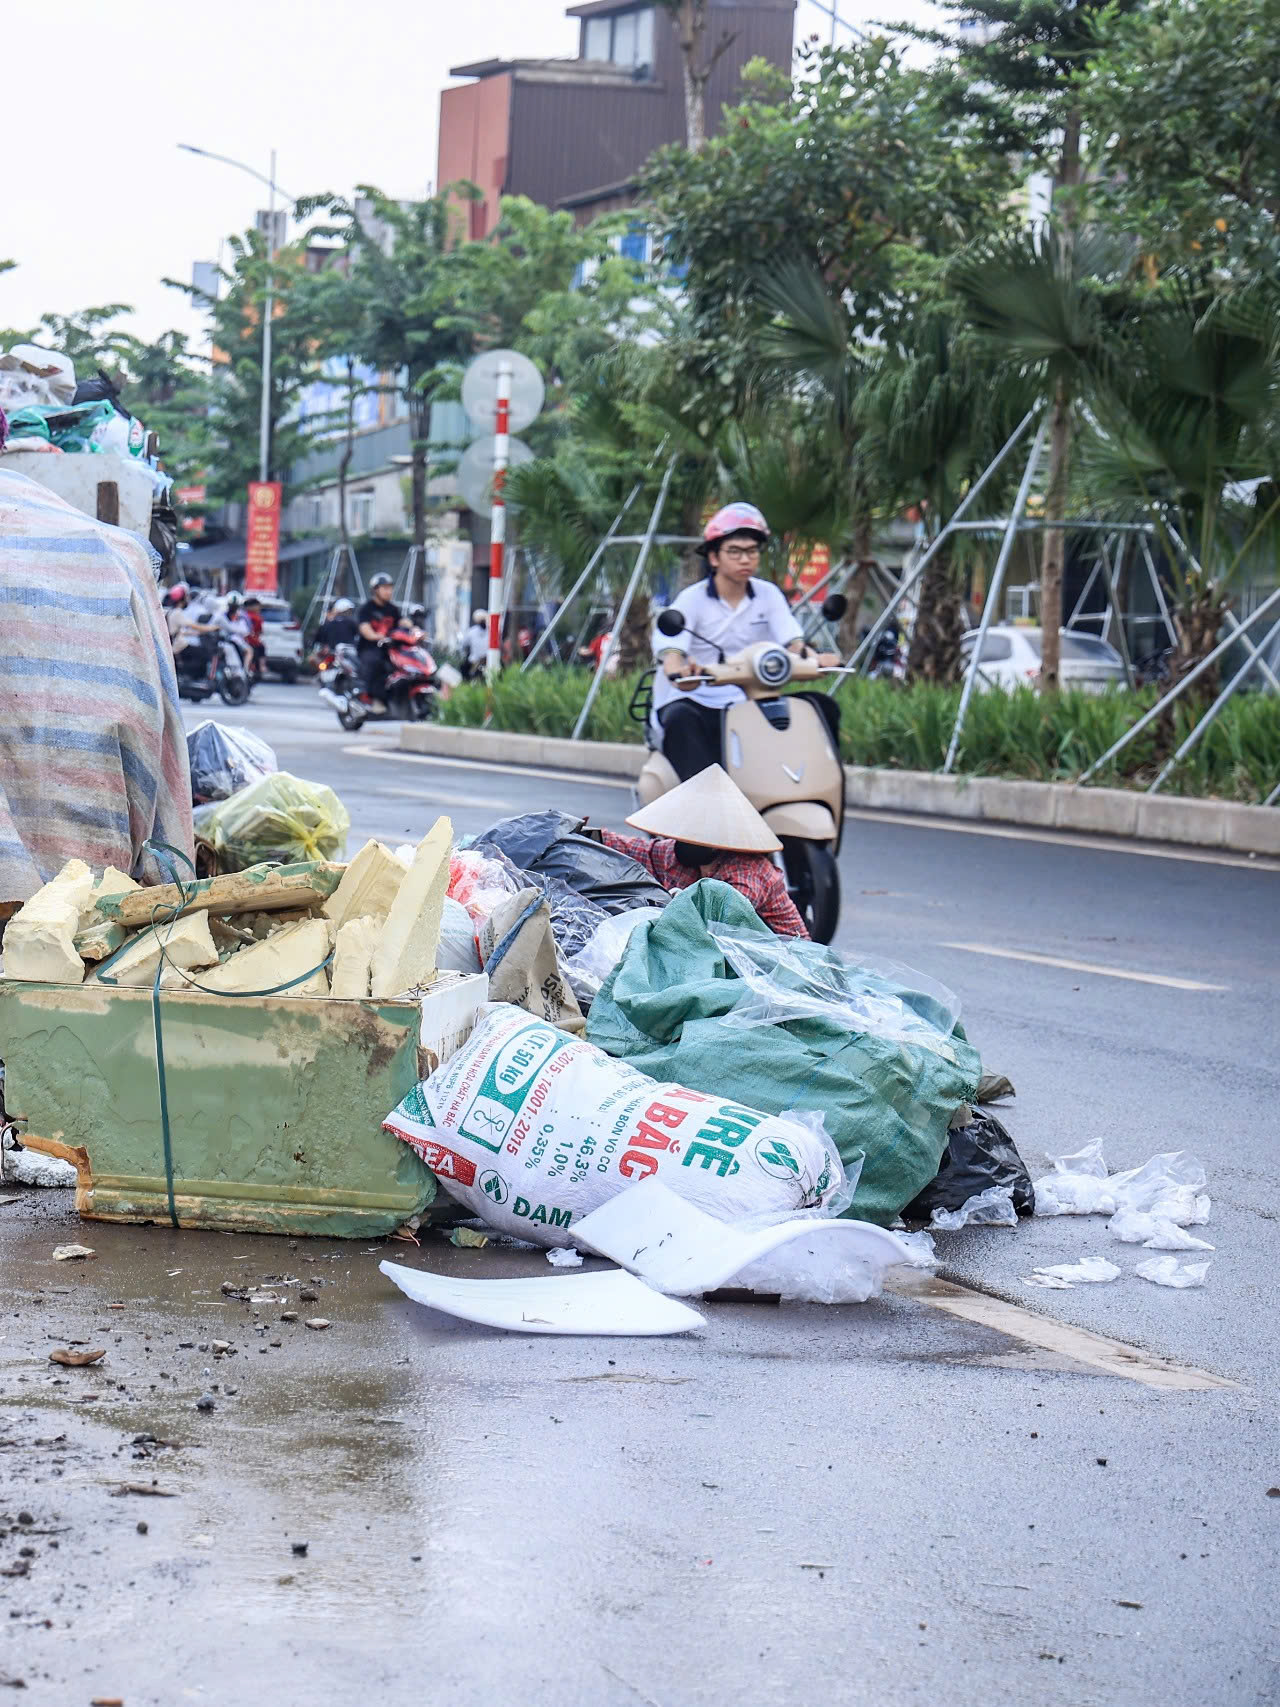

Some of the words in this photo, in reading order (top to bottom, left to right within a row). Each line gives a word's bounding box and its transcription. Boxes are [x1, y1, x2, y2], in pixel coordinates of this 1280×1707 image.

[541, 973, 561, 1001] ISO
[499, 1067, 524, 1086] kg
[513, 1048, 534, 1068] 50
[523, 1077, 552, 1120] 14001:
[506, 1118, 532, 1156] 2015
[524, 1123, 554, 1169] 0,35%
[620, 1101, 689, 1181] BẮC
[682, 1105, 769, 1177] URÊ
[547, 1141, 574, 1178] 1,0%
[569, 1135, 597, 1183] 46,3%
[512, 1196, 573, 1229] ĐẠM
